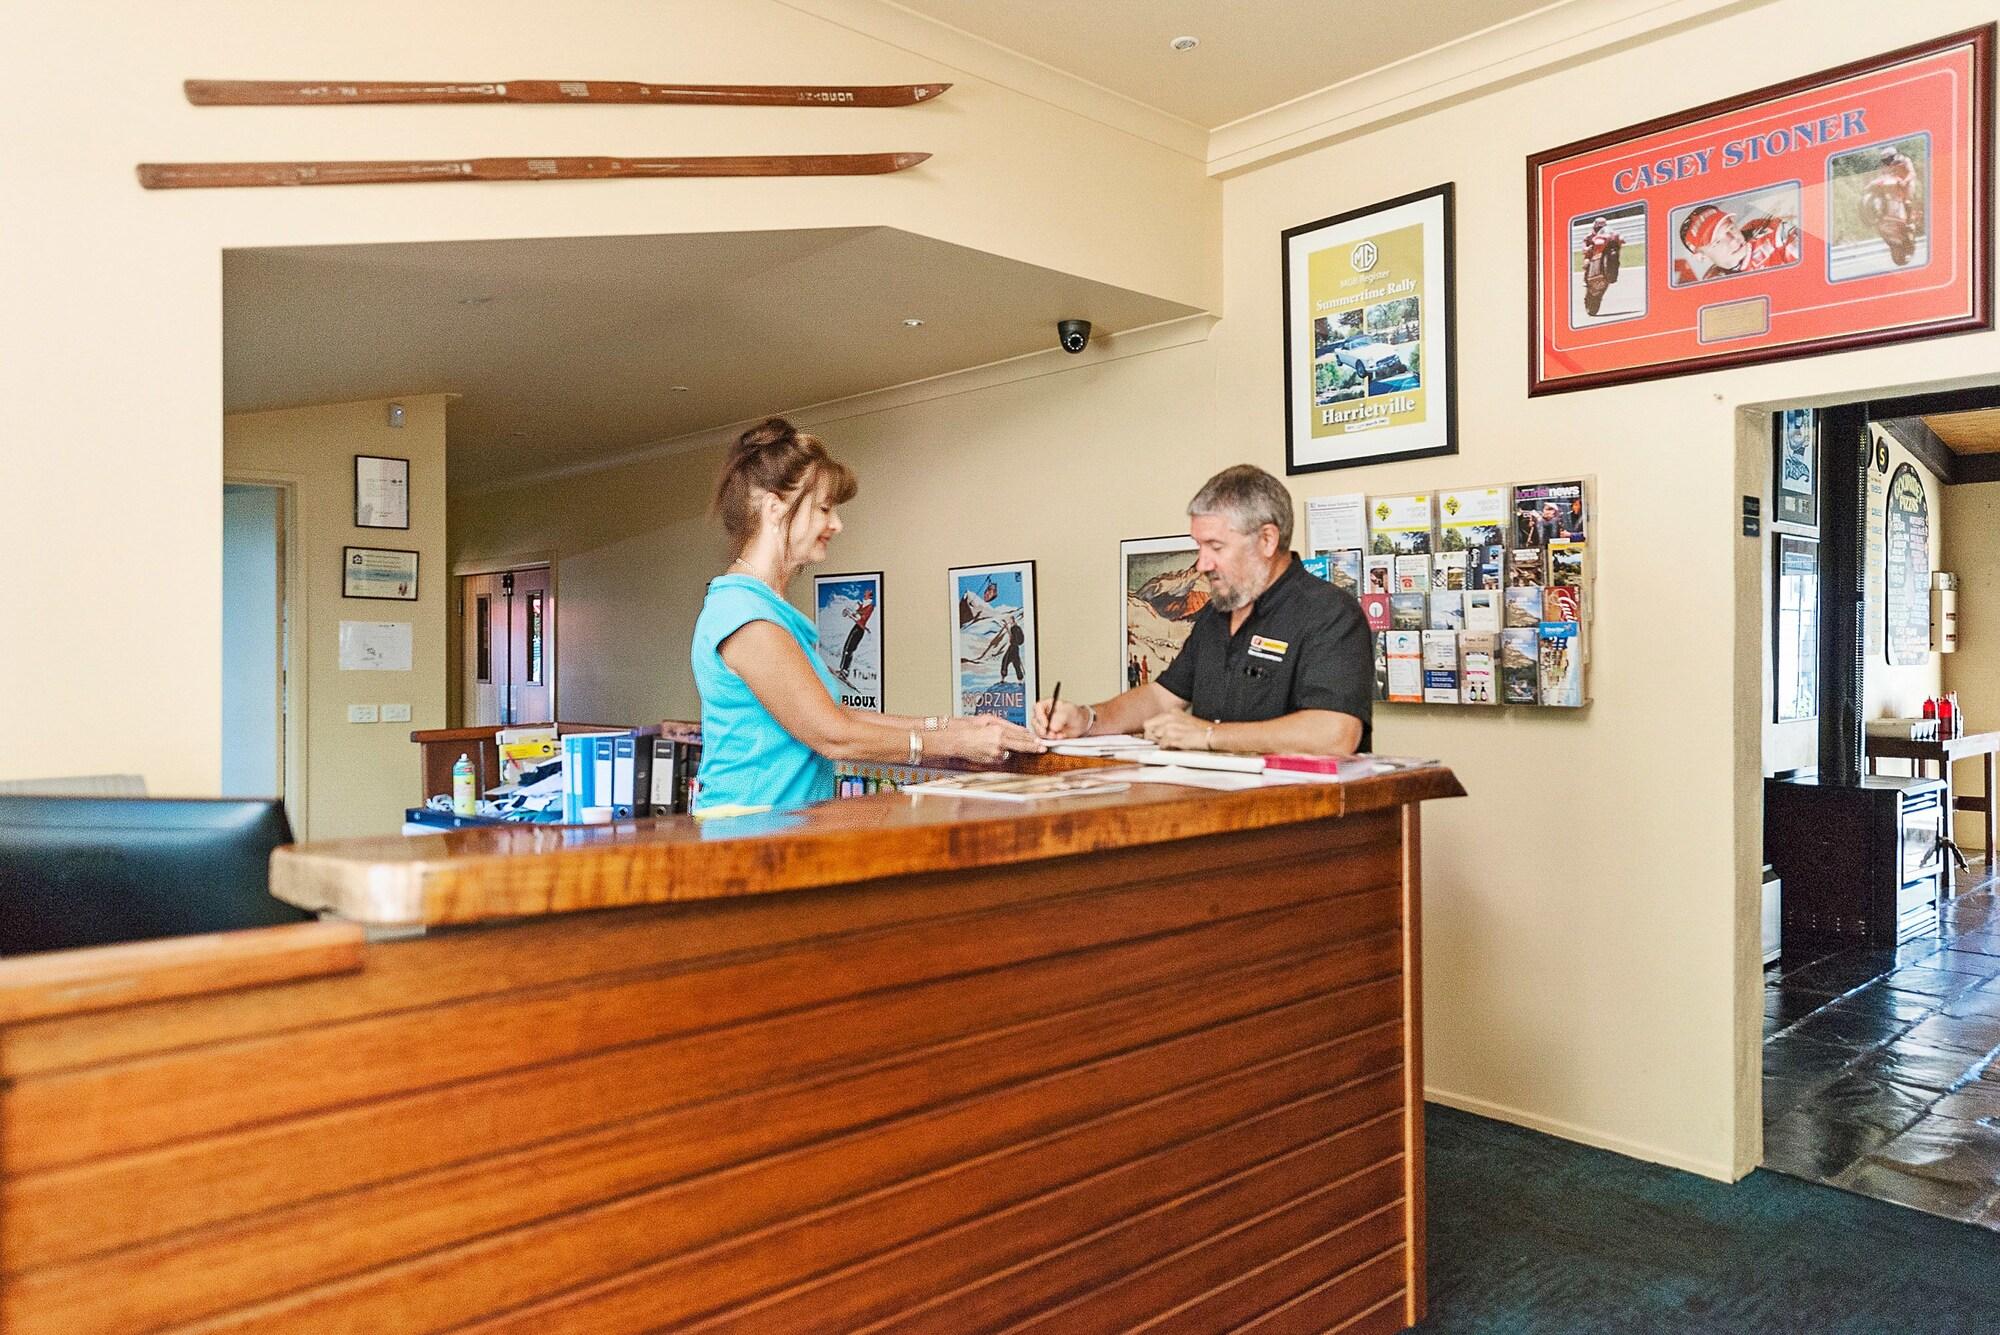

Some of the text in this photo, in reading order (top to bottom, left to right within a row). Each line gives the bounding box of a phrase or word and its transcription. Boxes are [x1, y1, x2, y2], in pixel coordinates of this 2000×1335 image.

[1614, 109, 1868, 194] CASEY STONER
[1353, 243, 1376, 269] MG
[1317, 278, 1417, 311] Summertime Rally
[1322, 397, 1415, 425] Harrietville
[963, 692, 1024, 707] MORZINE
